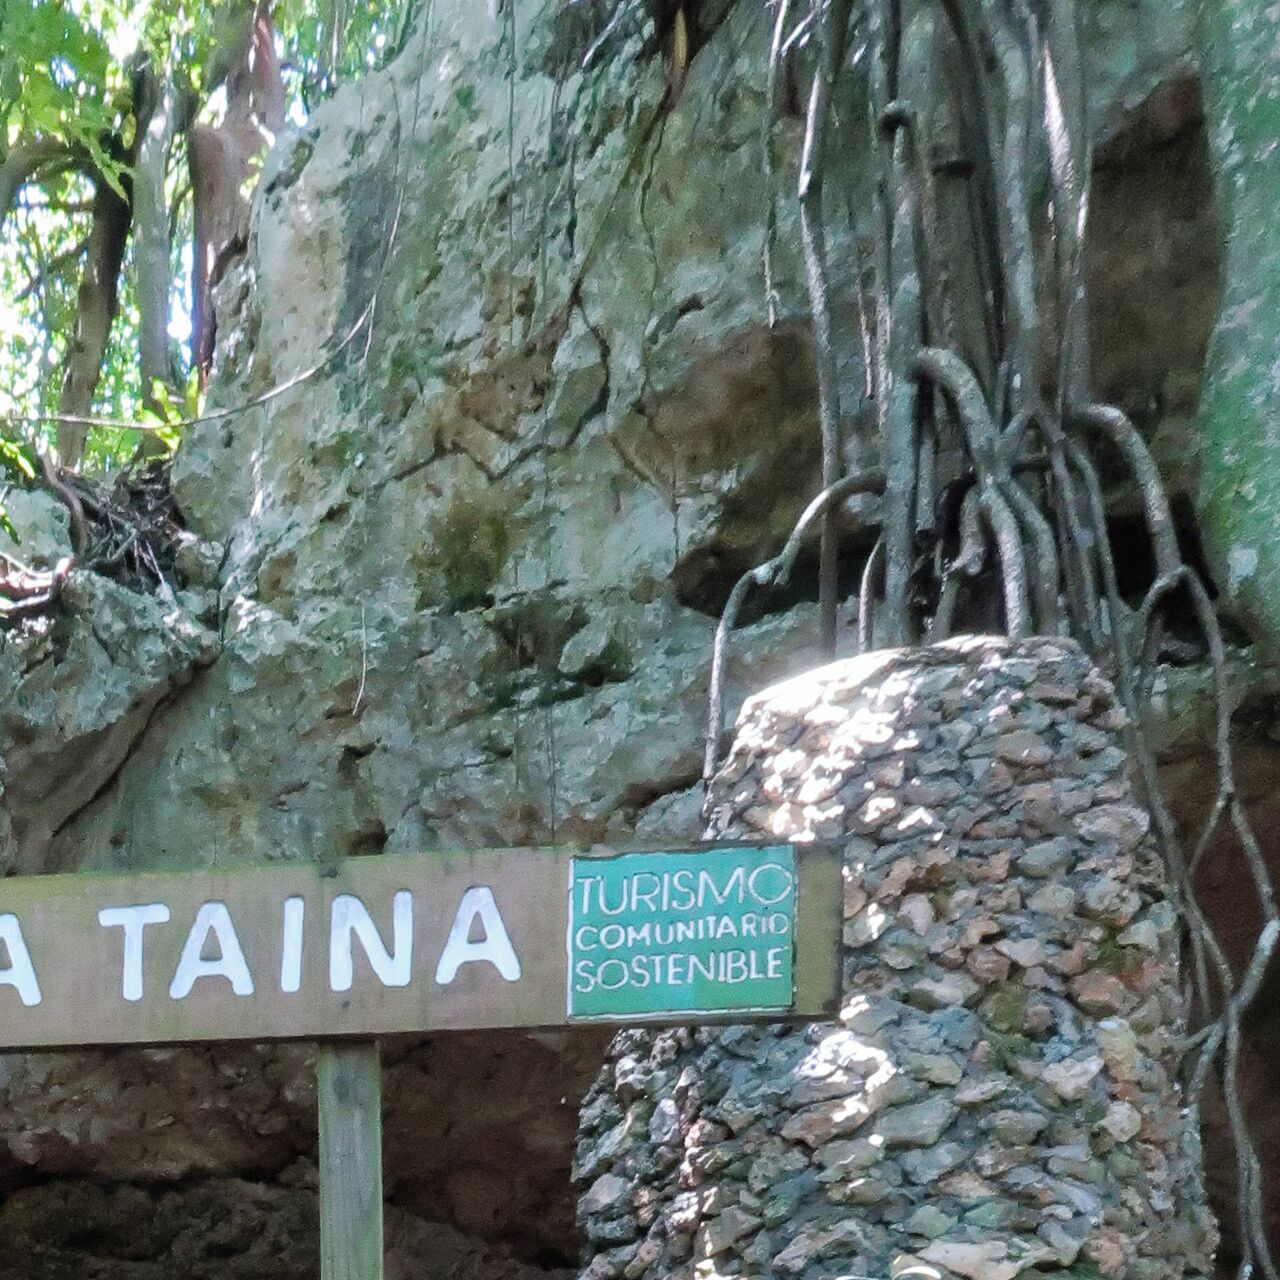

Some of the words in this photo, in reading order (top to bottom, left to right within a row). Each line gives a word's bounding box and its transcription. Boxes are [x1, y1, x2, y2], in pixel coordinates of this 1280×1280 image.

[576, 863, 793, 915] TURISMO
[98, 886, 520, 1001] TAINA
[575, 912, 789, 951] COMUNITARIO
[575, 947, 785, 992] SOSTENIBLE
